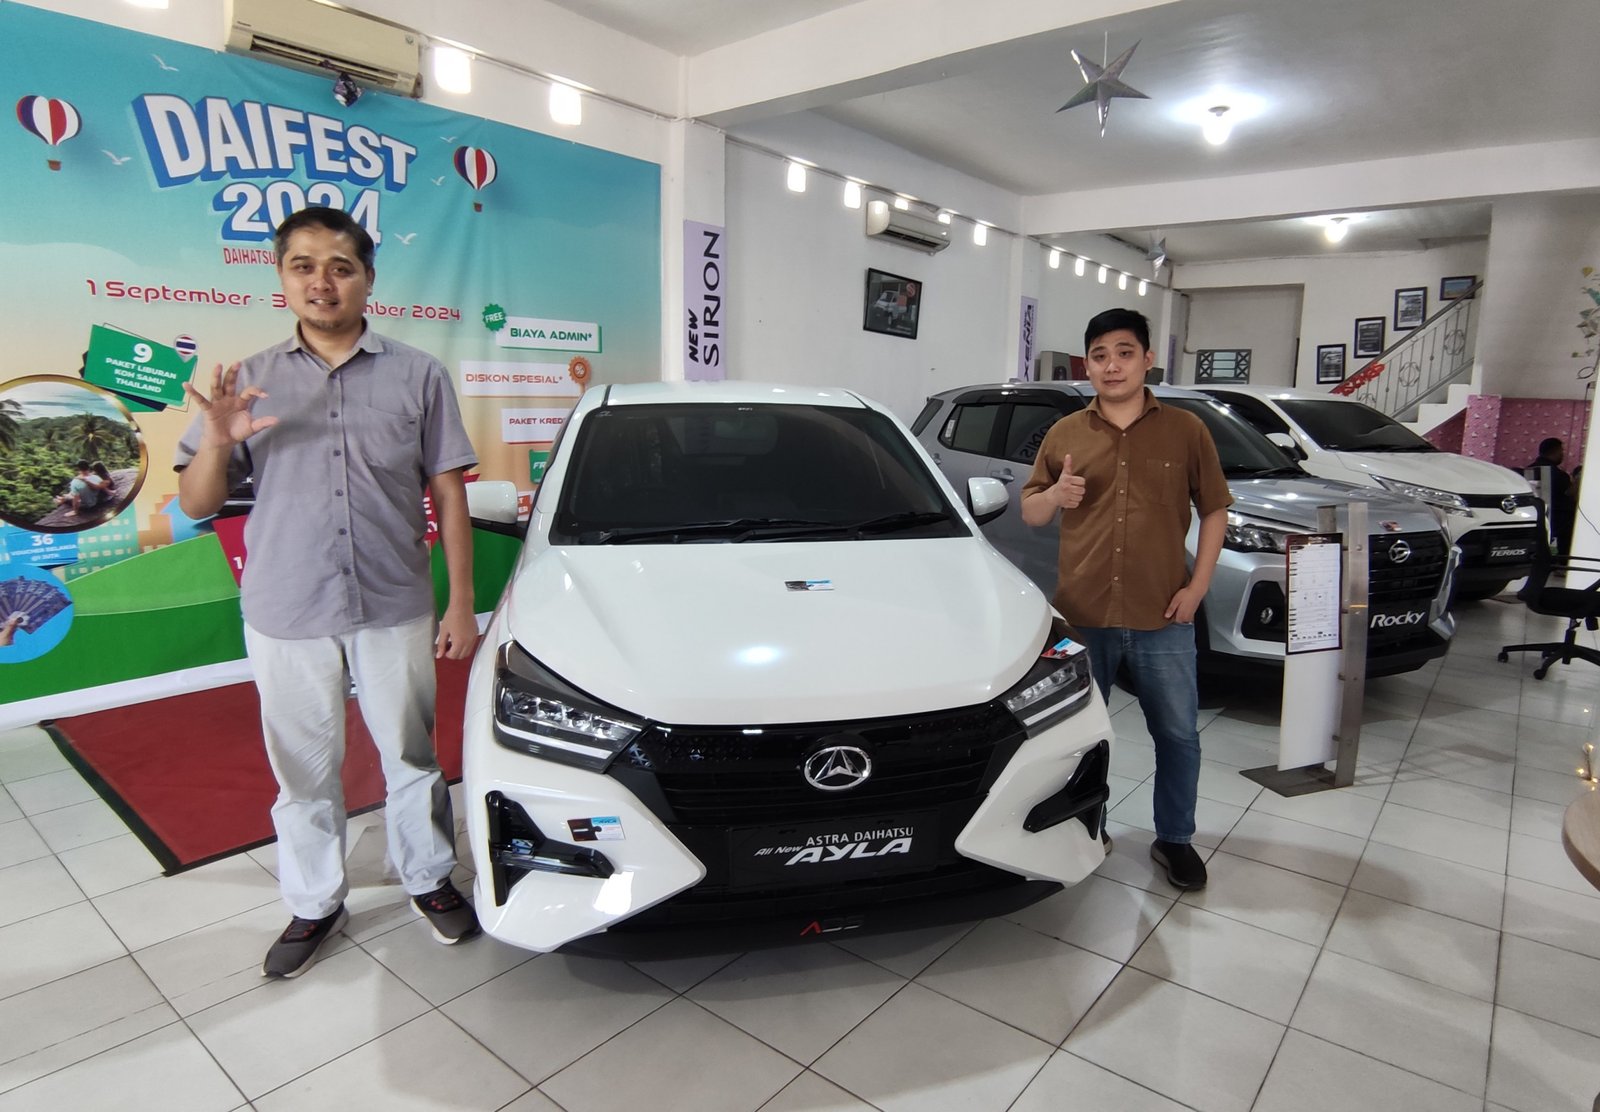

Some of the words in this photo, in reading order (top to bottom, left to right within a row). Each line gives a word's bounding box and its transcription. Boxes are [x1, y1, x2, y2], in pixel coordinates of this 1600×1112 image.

[136, 93, 417, 190] DAIFEST
[223, 247, 277, 265] DAIHATSU
[86, 279, 97, 296] 1
[105, 281, 251, 304] September
[412, 305, 460, 320] 2024
[703, 230, 721, 367] SIRION
[485, 311, 504, 323] FREE
[510, 328, 547, 339] BIAYA
[688, 308, 699, 363] NEW
[132, 343, 153, 363] 9
[105, 357, 136, 369] PAKET
[137, 365, 177, 379] LIBURAN
[114, 368, 135, 379] KOH
[135, 373, 166, 385] SAMUI
[115, 377, 162, 393] THAILAND
[465, 373, 510, 383] DISKON
[540, 417, 565, 425] KRED
[31, 533, 54, 547] 36
[1490, 548, 1527, 557] TERIOS
[1370, 611, 1426, 629] Rocky
[805, 833, 850, 847] ASTRA
[854, 827, 914, 842] DAIHATSU
[754, 847, 774, 857] All
[774, 845, 803, 854] New
[784, 837, 913, 866] AYLA
